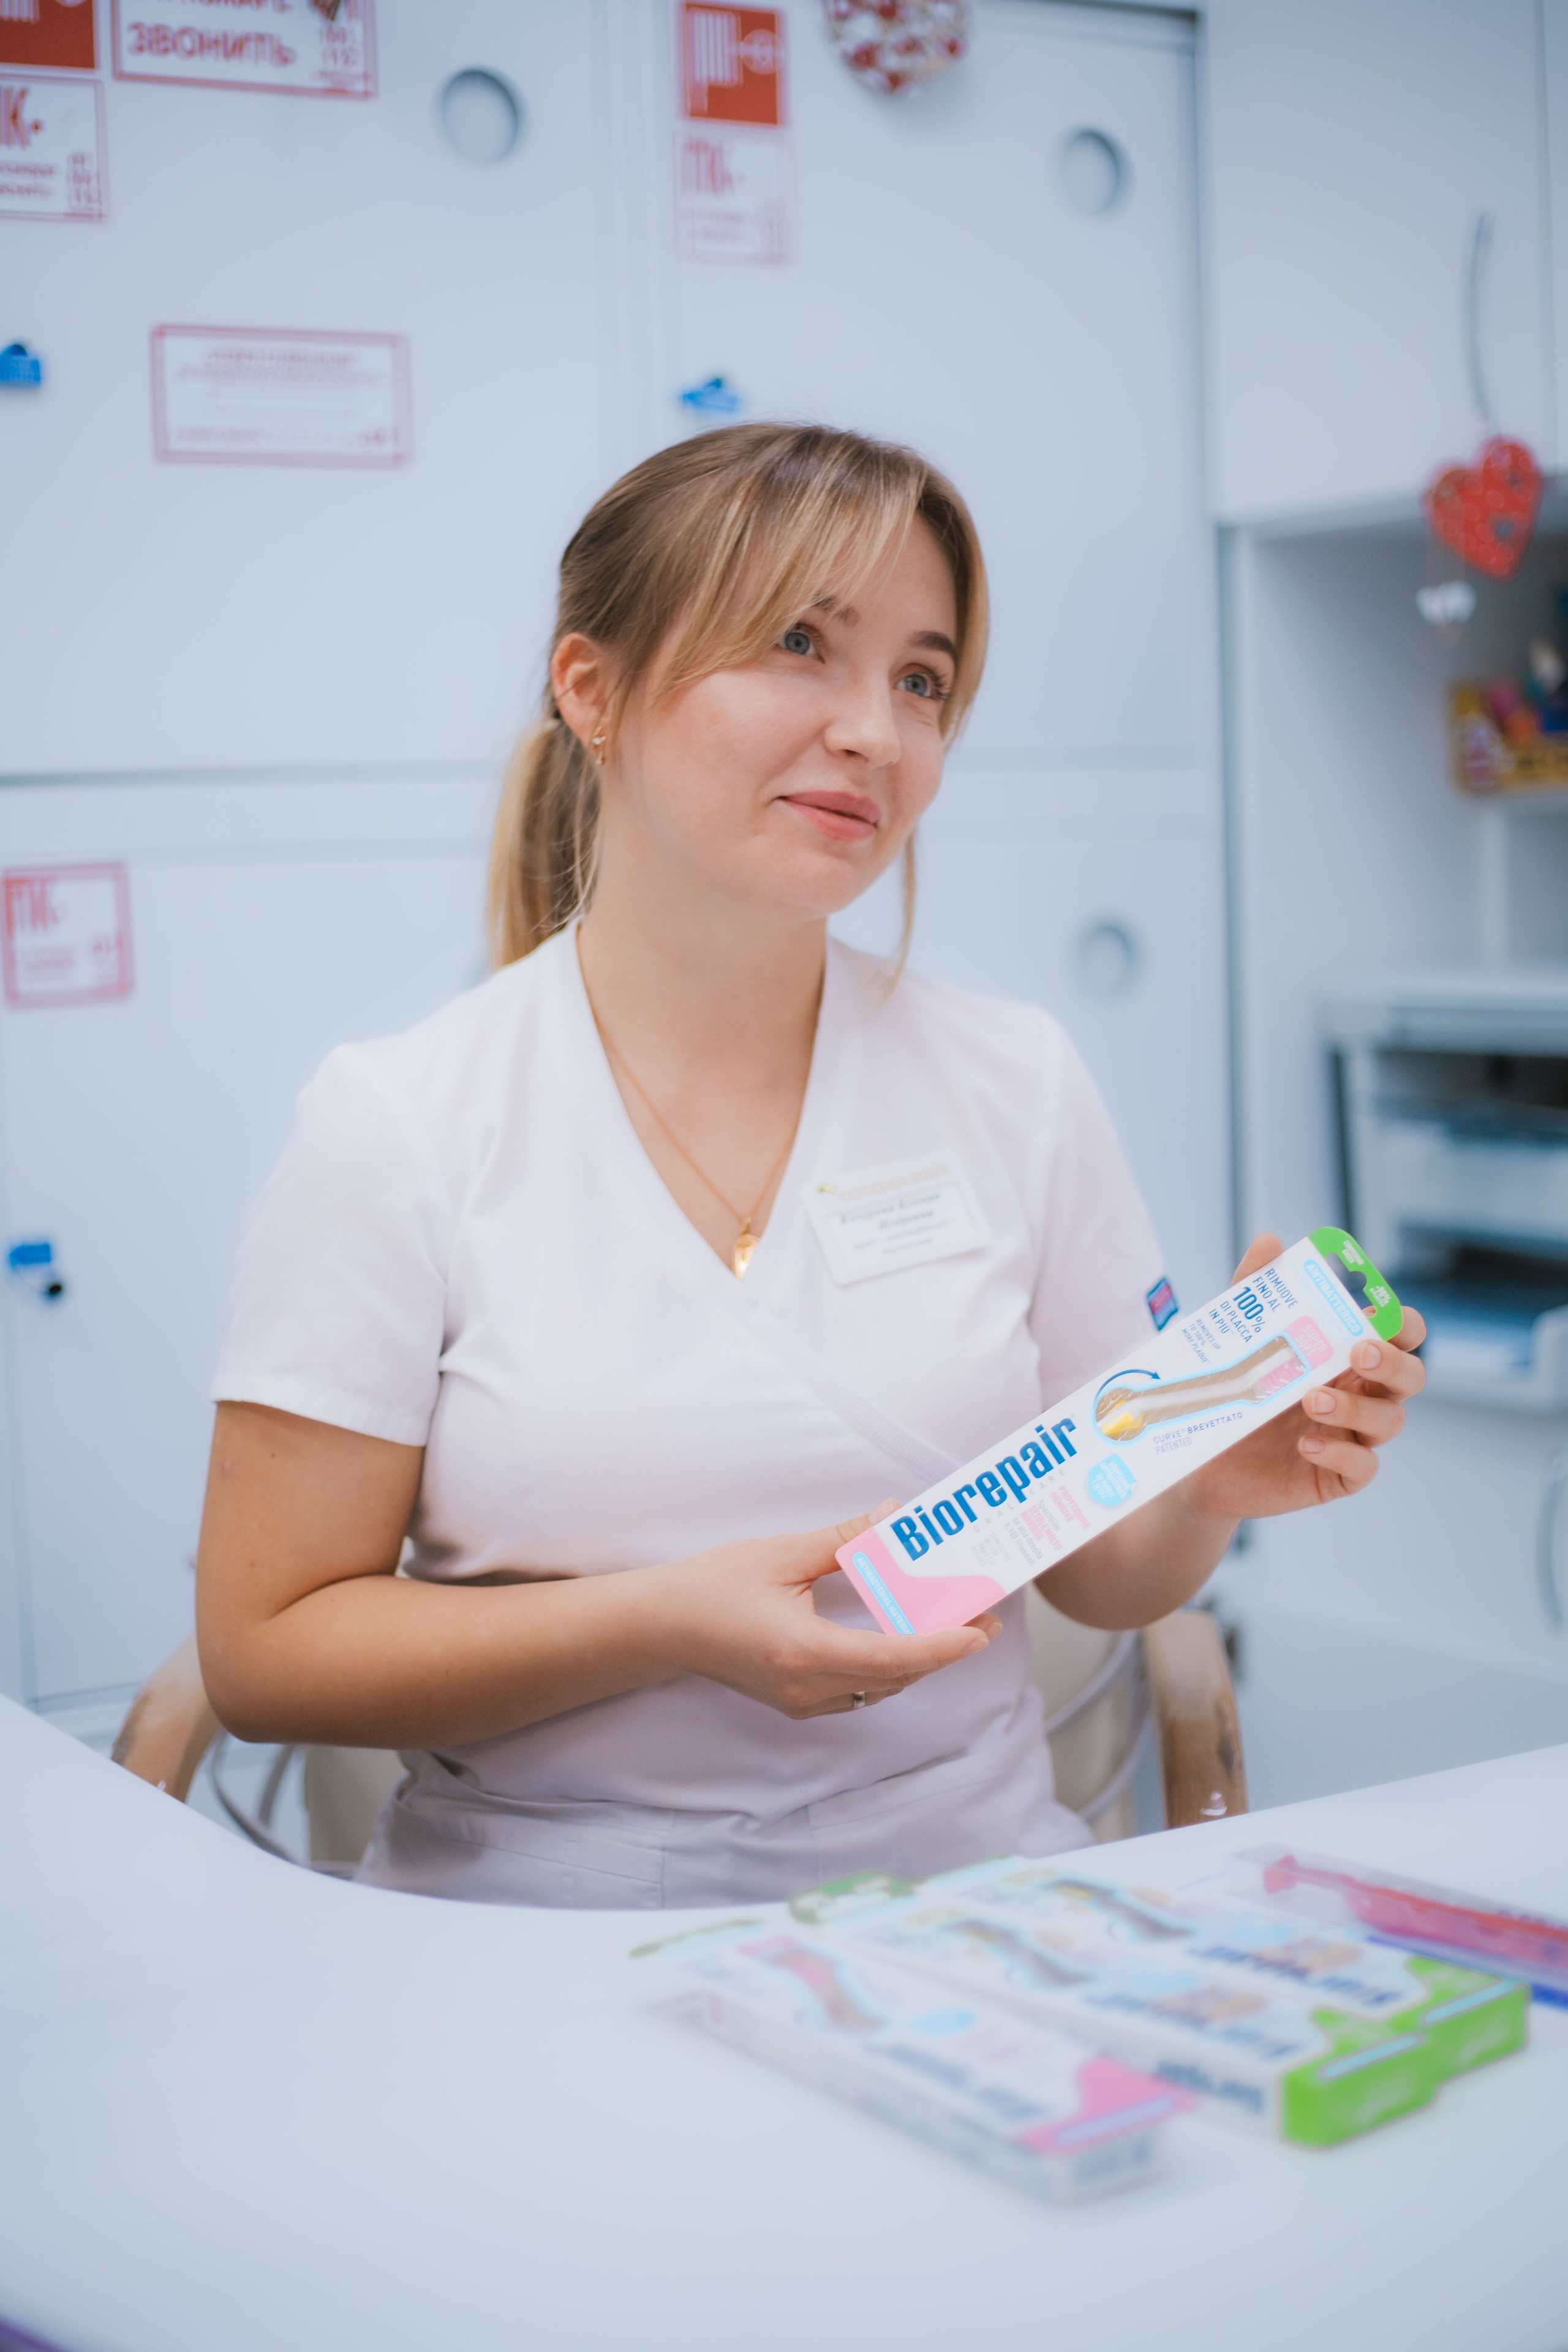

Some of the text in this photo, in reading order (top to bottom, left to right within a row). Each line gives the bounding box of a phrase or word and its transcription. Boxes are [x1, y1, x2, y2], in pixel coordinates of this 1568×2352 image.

[128, 22, 297, 66] ЗВОНИТЬ
[1253, 1276, 1281, 1311] FINO AL
[1264, 1268, 1298, 1309] RIMUOVE
[1305, 1262, 1360, 1333] ANTIBATTERICO
[1208, 1308, 1219, 1319] IN
[1220, 1301, 1253, 1342] DI PLACCA
[1231, 1286, 1273, 1333] 100%
[1181, 1328, 1194, 1344] MORE
[1195, 1318, 1220, 1350] REMOVES UP
[1294, 1333, 1314, 1357] SOFT
[1302, 1324, 1327, 1353] SUPER
[1187, 1412, 1243, 1434] BREVETTATO
[1156, 1436, 1192, 1455] PATENTED
[890, 1417, 1077, 1562] Biorepair
[973, 1468, 1066, 1532] ORAL CARE
[1058, 1485, 1091, 1529] PROTEZIONE
[1044, 1528, 1062, 1551] MOLTO
